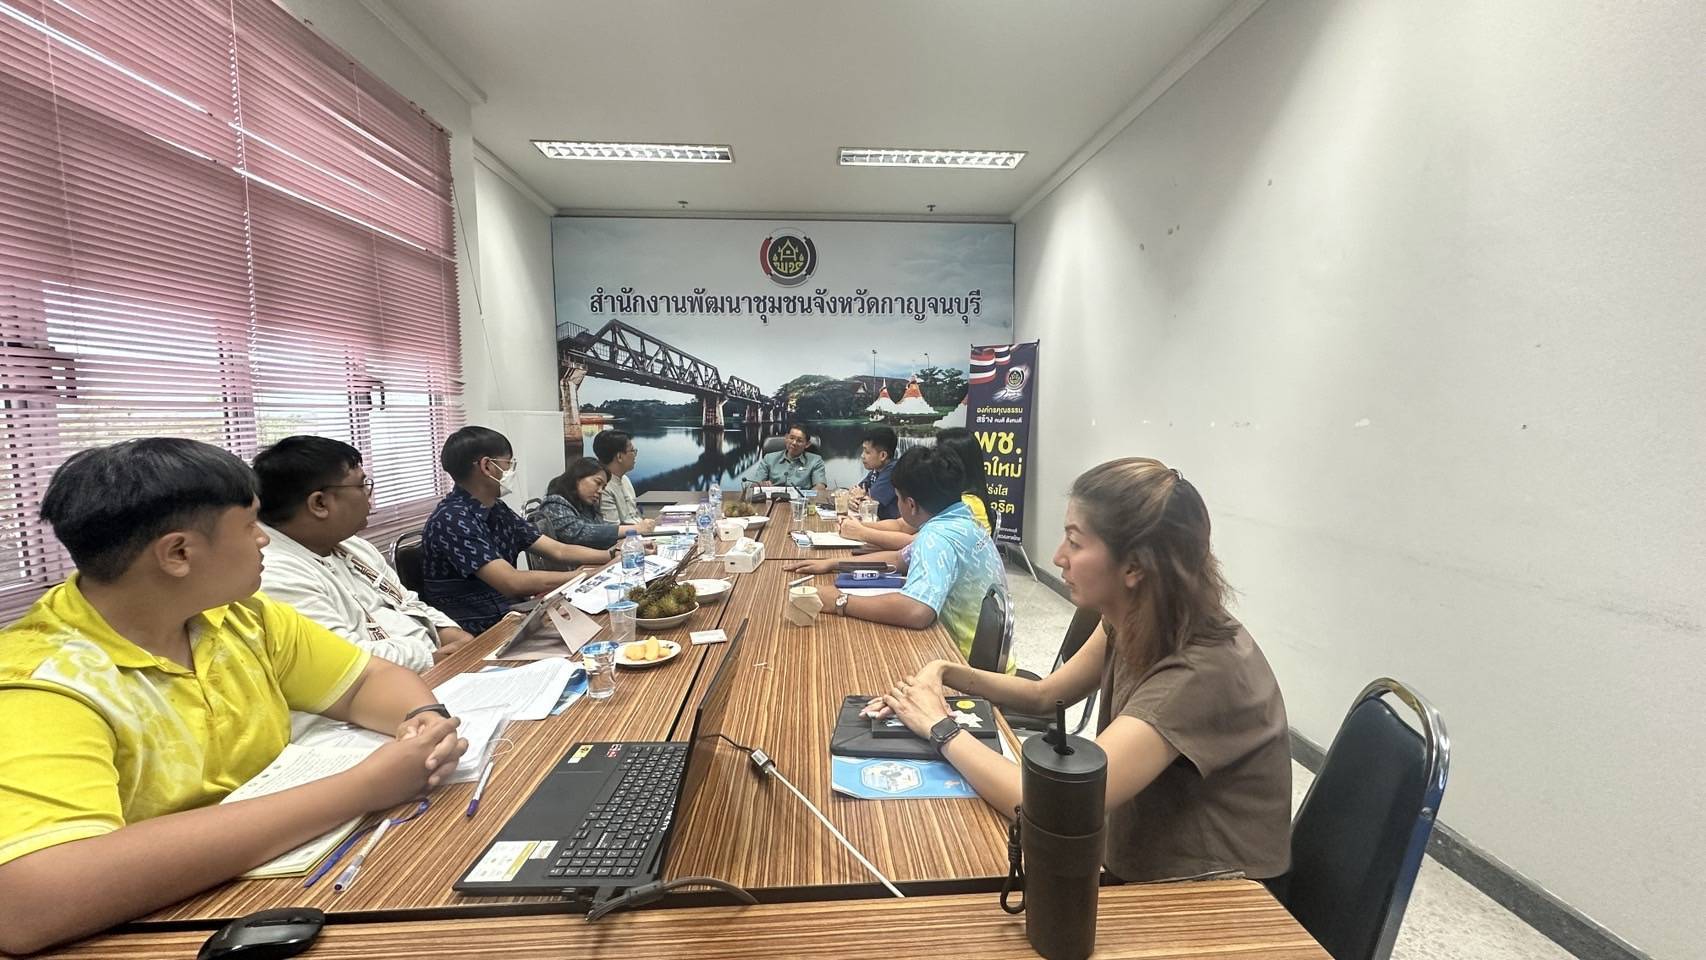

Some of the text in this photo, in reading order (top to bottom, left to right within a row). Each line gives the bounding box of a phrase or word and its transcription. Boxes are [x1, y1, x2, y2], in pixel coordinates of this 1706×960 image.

[590, 287, 981, 324] สำนักงานพัฒนาชุมชนจังหวัดกาญจนบุรี
[976, 414, 993, 423] สร้าง
[983, 456, 1022, 478] คใหม่
[990, 499, 1015, 514] จริต
